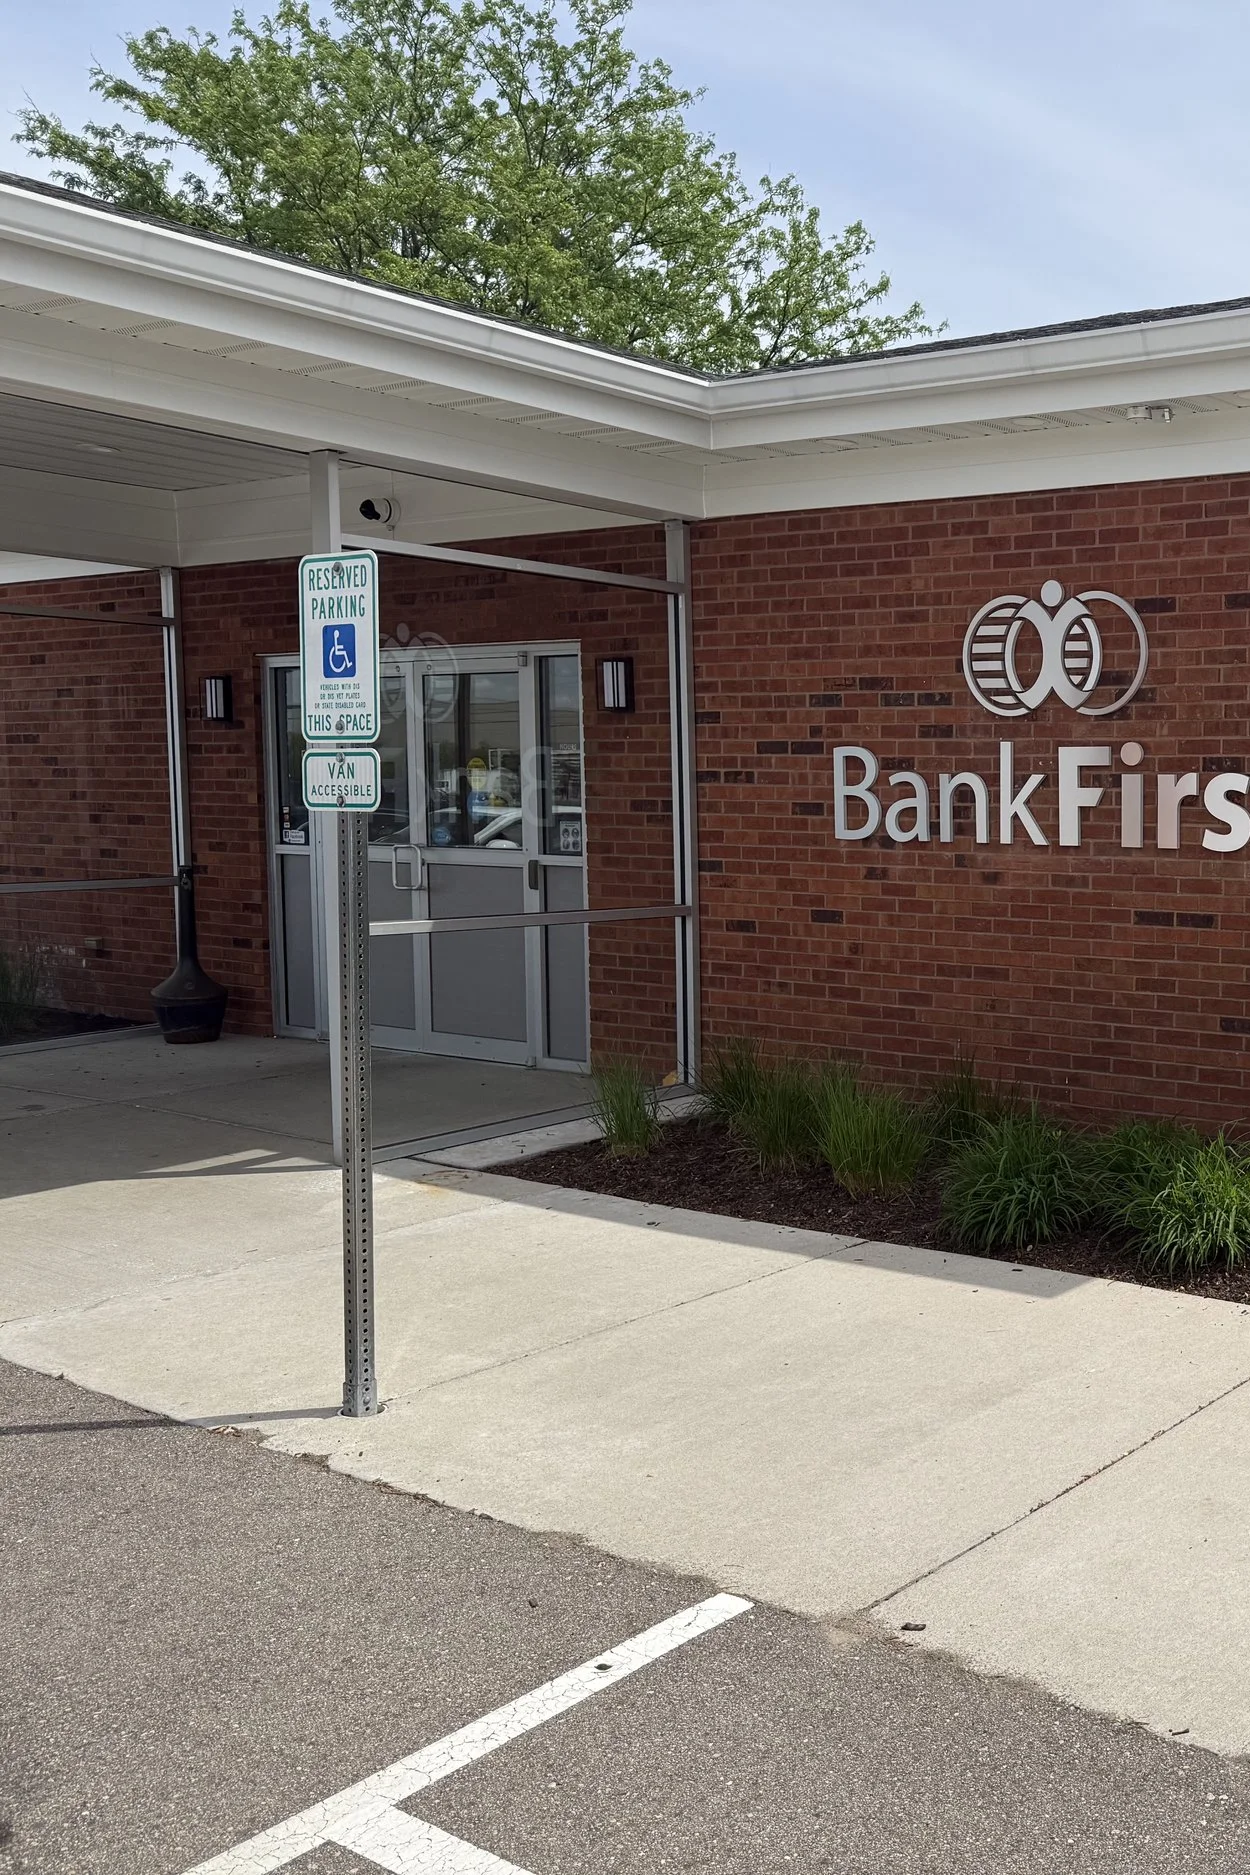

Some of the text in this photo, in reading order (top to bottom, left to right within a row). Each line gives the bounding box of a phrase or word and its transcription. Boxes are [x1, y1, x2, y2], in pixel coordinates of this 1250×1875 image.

[308, 564, 367, 591] RESERVED
[311, 594, 365, 620] PARKING
[307, 714, 332, 731] THIS
[327, 762, 355, 779] VAN
[311, 784, 372, 796] ACCESSIBLE
